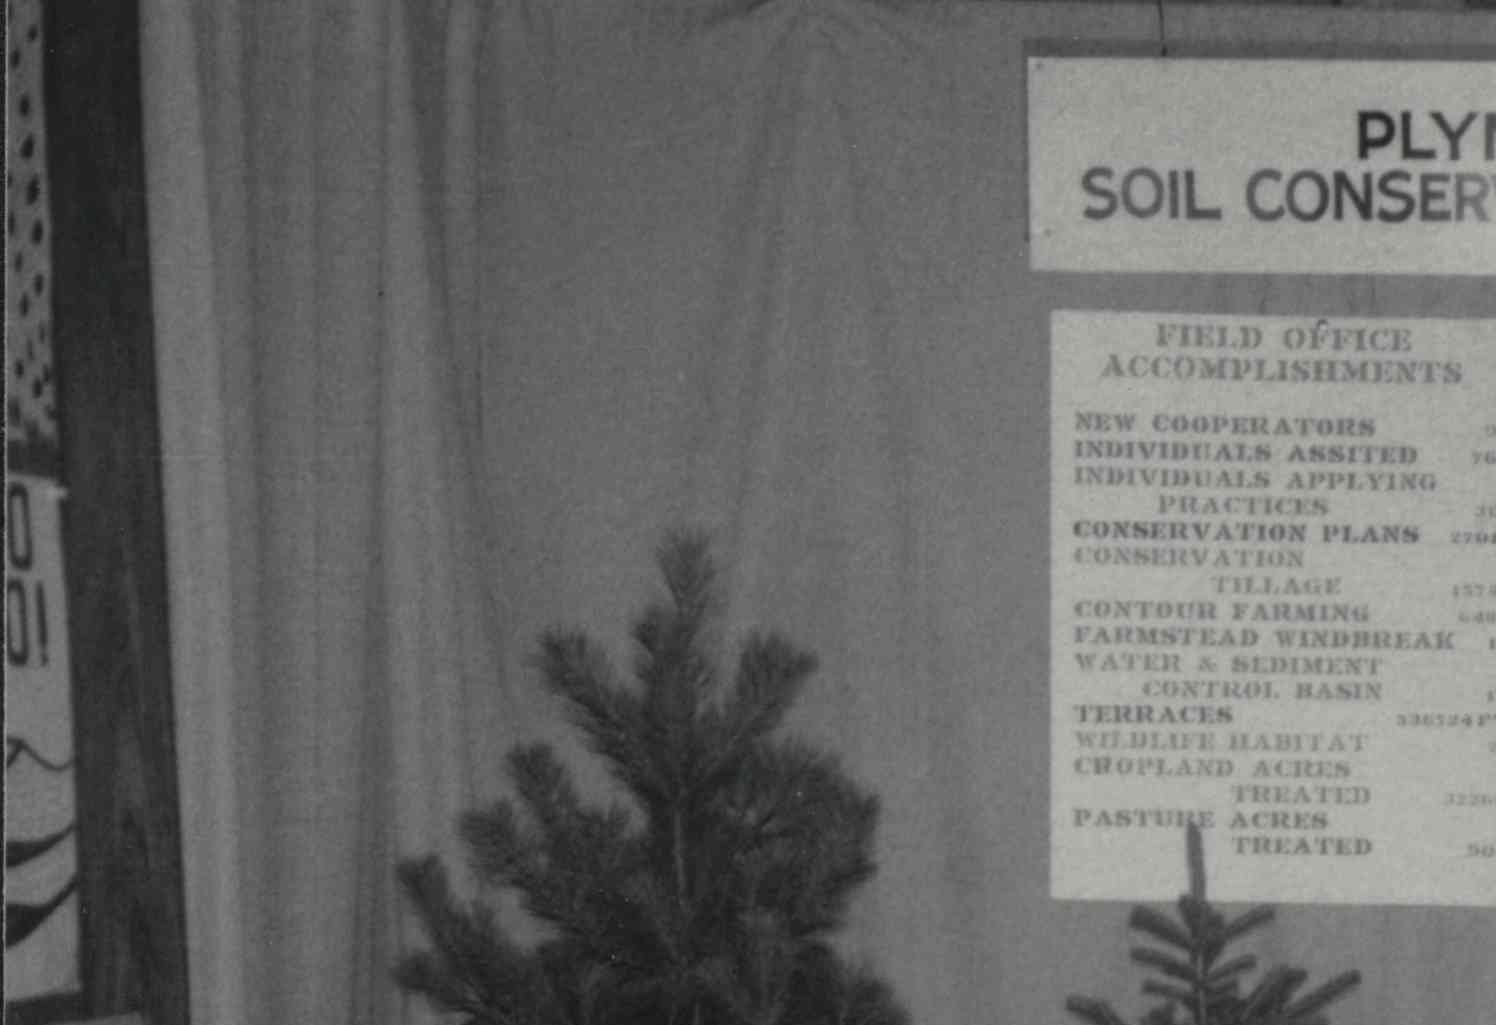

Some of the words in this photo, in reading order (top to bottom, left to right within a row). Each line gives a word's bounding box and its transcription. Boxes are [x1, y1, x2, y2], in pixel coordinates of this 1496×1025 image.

[1081, 167, 1222, 221] SOIL
[1155, 323, 1263, 351] FIELD
[1284, 326, 1413, 353] OFFICE
[1102, 354, 1463, 384] ACCOMPLISHMENTS
[1074, 412, 1137, 433] NEW
[1152, 413, 1375, 438] COOPERATORS
[1074, 441, 1272, 463] INDIVIDUALS
[1288, 443, 1418, 465] ASSITED
[1074, 467, 1271, 489] INDIVIDUALS
[1285, 469, 1438, 491] APPLYING
[1157, 494, 1329, 517] PRACTICES
[1073, 522, 1306, 543] CONSERVATION
[1322, 524, 1419, 545] PLANS
[1074, 548, 1305, 569] CONSERVATION
[1214, 574, 1342, 596] TILLAGE
[1073, 600, 1217, 621] CONTOUR
[1231, 602, 1370, 624] FARMING
[1073, 625, 1259, 648] FARMSTEAD
[1276, 630, 1456, 650] WINDBREAK
[1074, 653, 1181, 673] WATER
[1200, 656, 1216, 672] &
[1230, 655, 1384, 676] SEDIMENT
[1142, 680, 1281, 700] CONTROL
[1296, 681, 1384, 700] BASIN
[1072, 704, 1234, 724] TERRACES
[1072, 731, 1215, 752] WILDLIFE
[1228, 732, 1369, 753] HABITAT
[1073, 756, 1235, 778] CROPLAND
[1252, 759, 1352, 778] ACRES
[1230, 785, 1372, 806] TREATED
[1072, 808, 1216, 829] PASTURE
[1230, 812, 1329, 831] ACRES
[1231, 837, 1374, 857] TREATED
